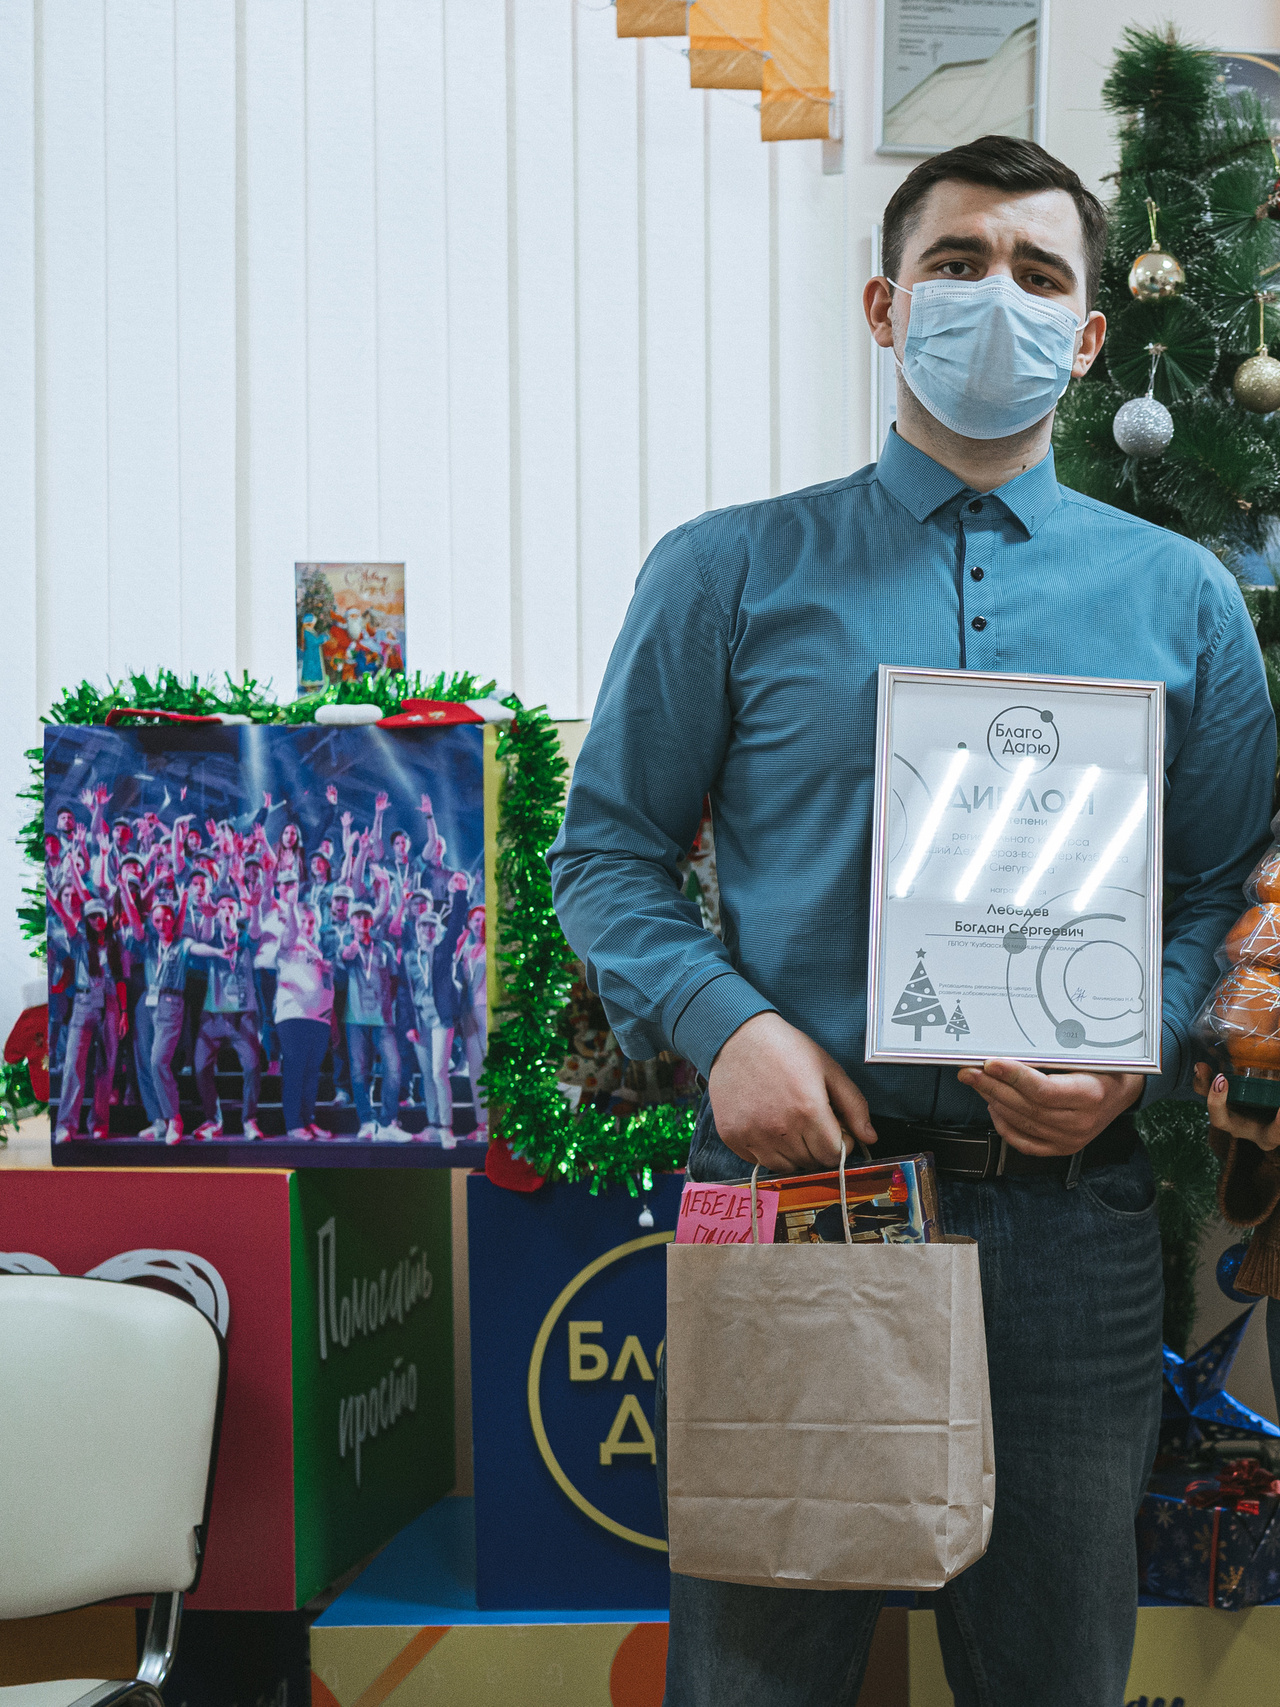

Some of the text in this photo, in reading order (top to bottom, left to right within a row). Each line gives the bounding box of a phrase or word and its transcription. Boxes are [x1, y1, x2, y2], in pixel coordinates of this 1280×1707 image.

[995, 723, 1042, 739] Благо
[1002, 739, 1051, 756] Дарю
[1005, 817, 1048, 827] тепени
[987, 904, 1049, 917] Лебедев
[955, 921, 1084, 937] Богдан Сергеевич
[1063, 1031, 1078, 1039] 2021
[681, 1189, 764, 1220] ЛЕБЕДЕВ
[569, 1321, 664, 1381] Бл
[338, 1357, 418, 1489] просто
